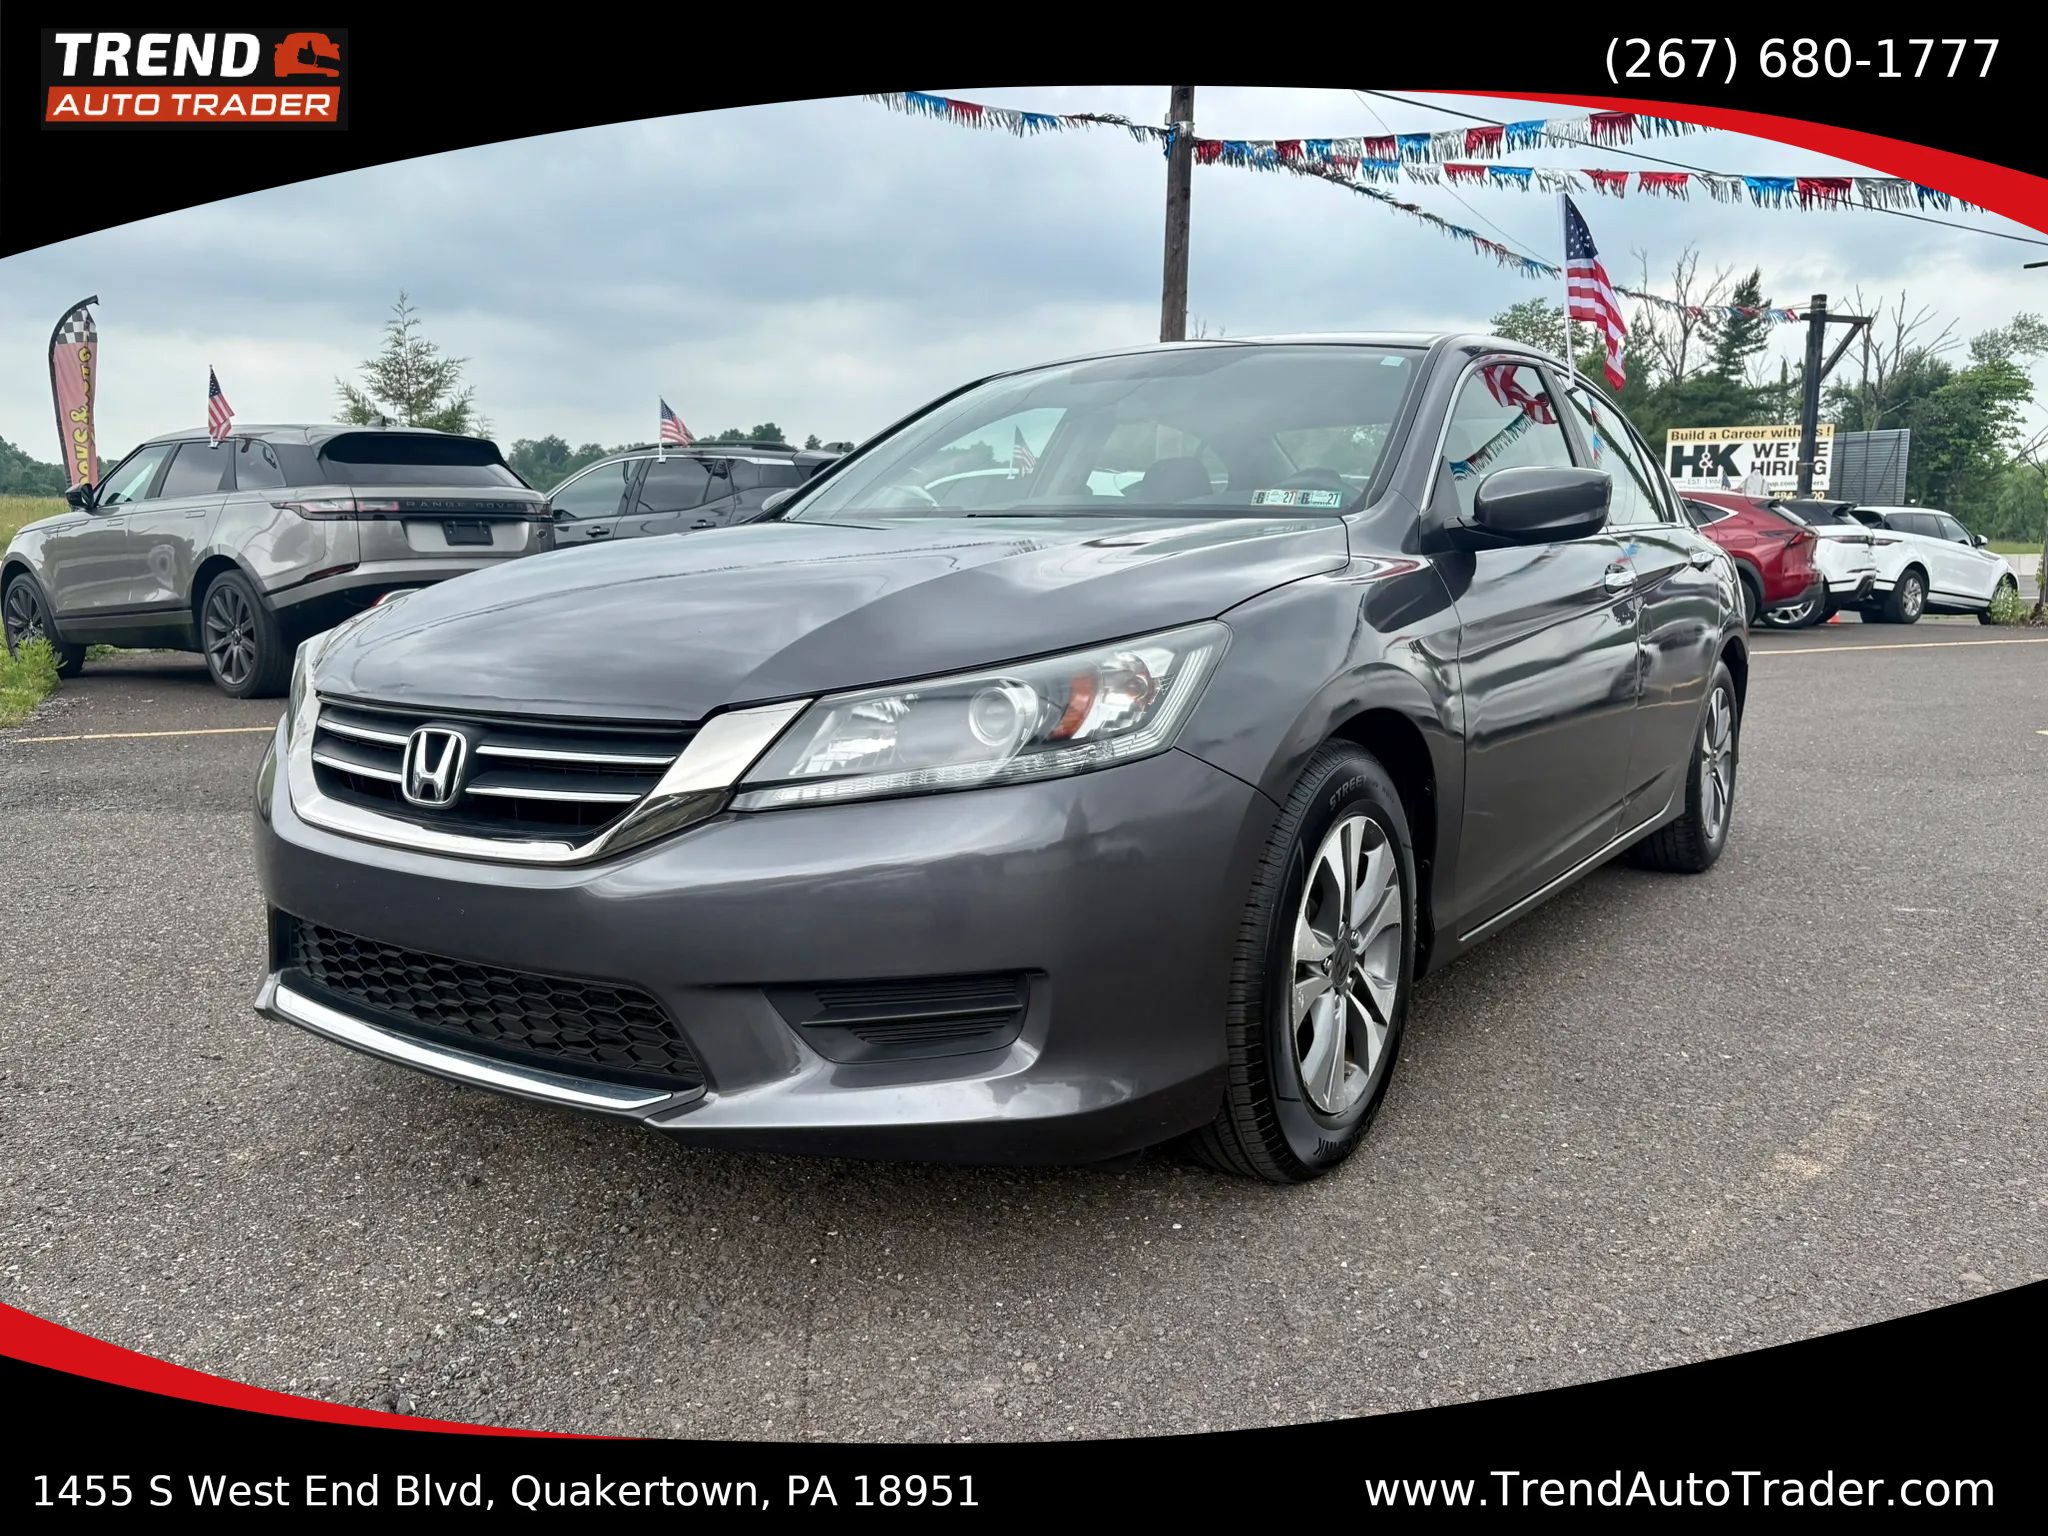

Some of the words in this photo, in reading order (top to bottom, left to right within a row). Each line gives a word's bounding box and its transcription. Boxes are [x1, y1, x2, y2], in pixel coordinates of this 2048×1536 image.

[1671, 430, 1705, 441] Build
[1708, 432, 1717, 440] a
[1721, 429, 1765, 440] Career
[1771, 427, 1801, 438] with
[1753, 441, 1829, 458] WE'E
[1671, 443, 1744, 478] H&K
[1751, 460, 1827, 477] HIRIG
